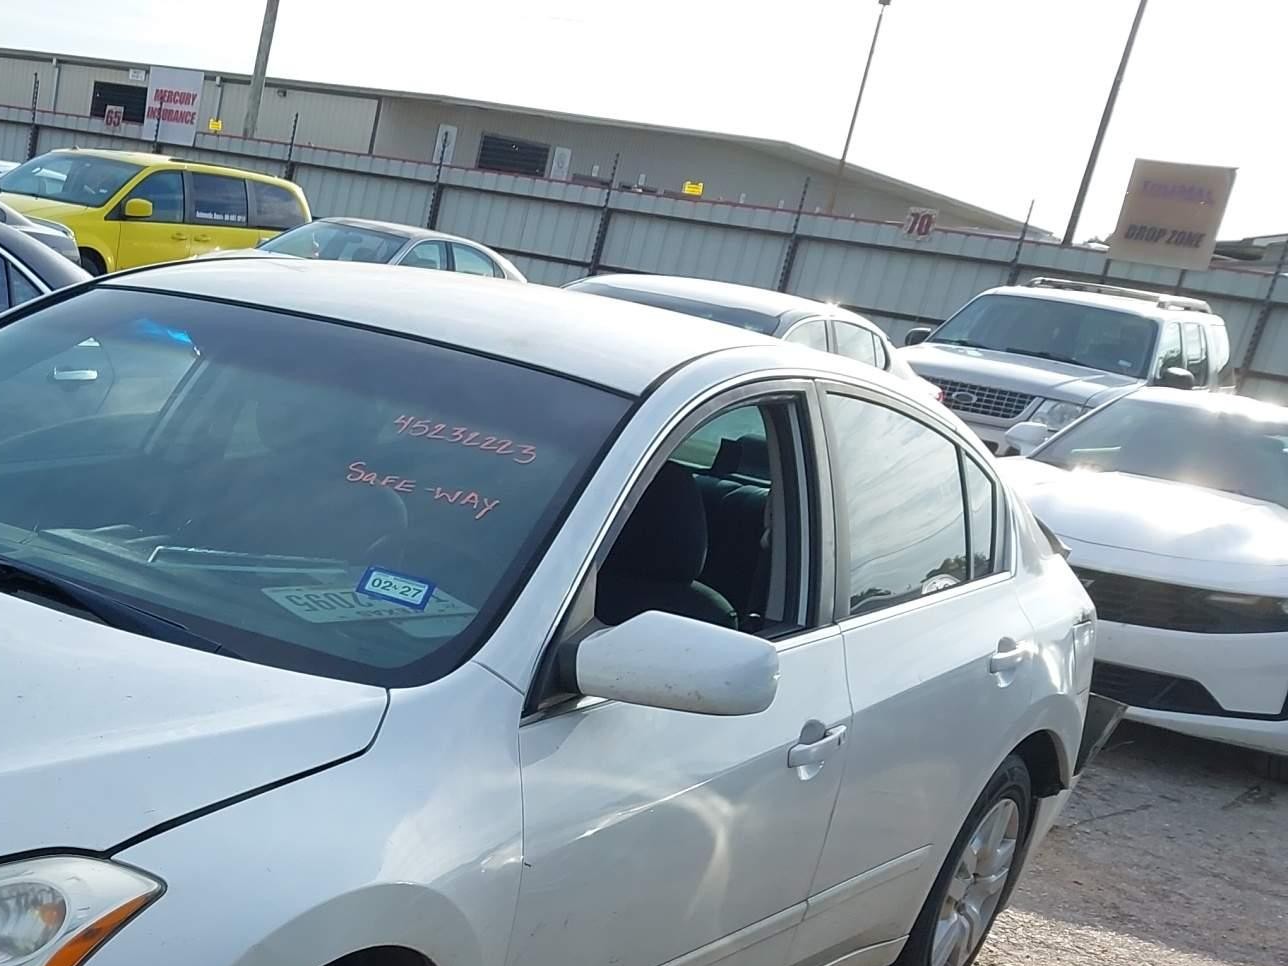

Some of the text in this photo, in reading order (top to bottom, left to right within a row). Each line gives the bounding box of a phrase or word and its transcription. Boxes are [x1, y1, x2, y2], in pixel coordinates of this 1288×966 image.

[154, 89, 198, 106] MERCURY
[105, 109, 122, 127] 65
[147, 106, 197, 125] INSURANCE
[393, 414, 537, 464] 45232223
